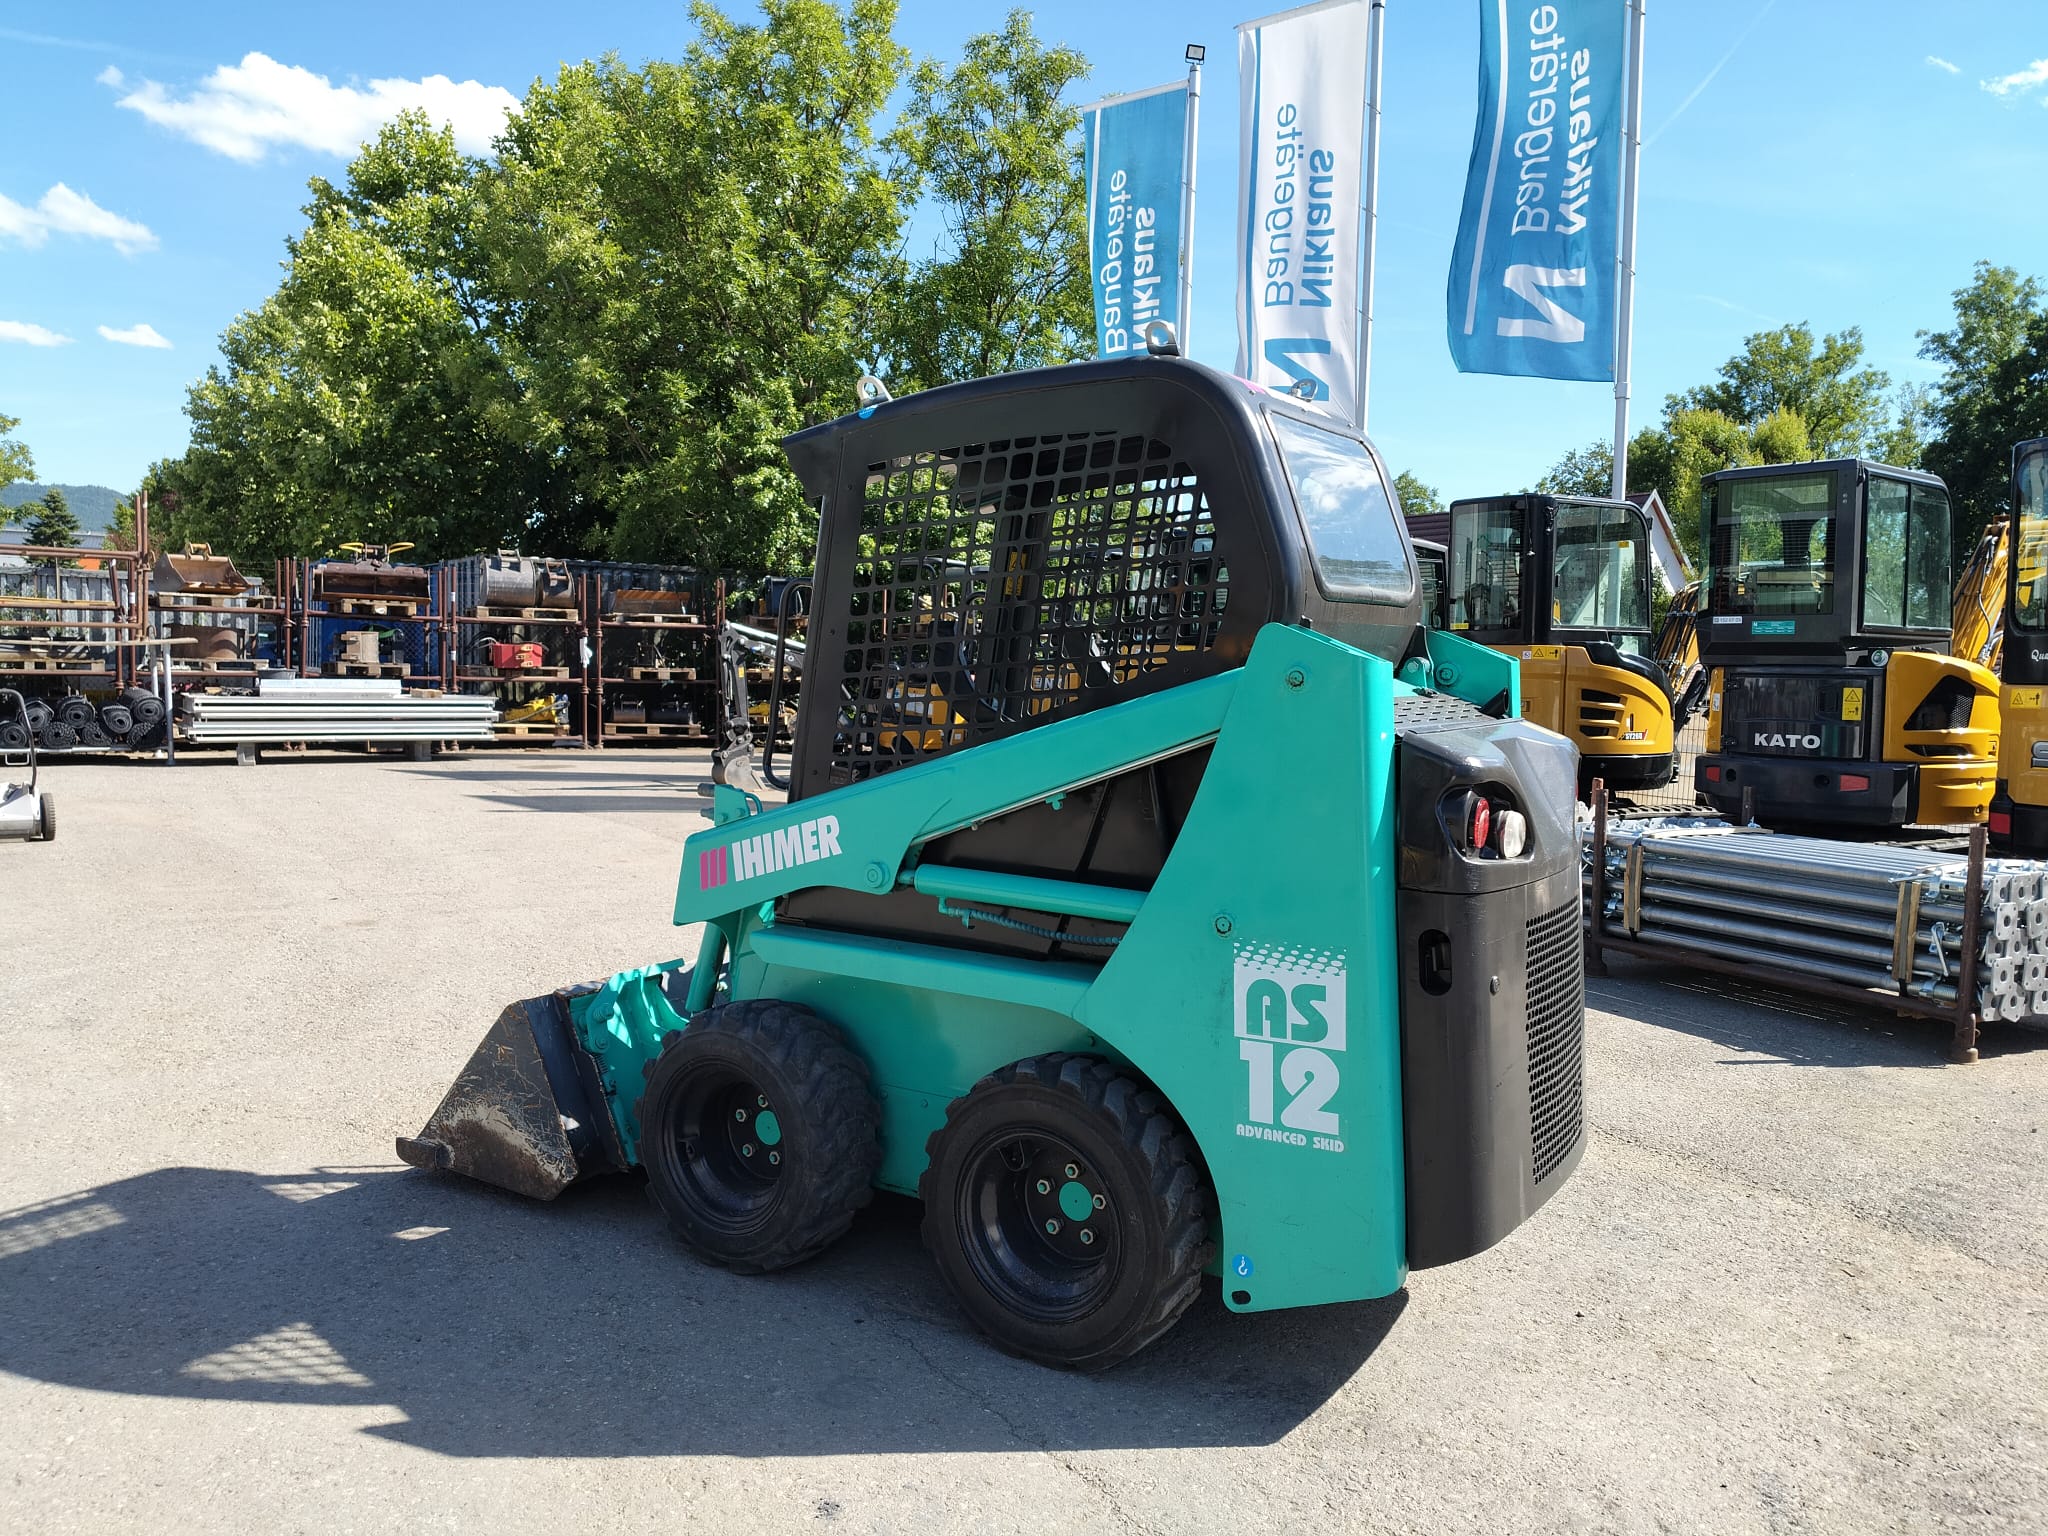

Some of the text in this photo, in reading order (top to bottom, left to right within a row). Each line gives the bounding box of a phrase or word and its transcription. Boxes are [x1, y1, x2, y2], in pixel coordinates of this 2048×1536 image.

[1754, 732, 1821, 749] KATO
[731, 814, 843, 882] IHIMER
[1246, 978, 1329, 1043] AS
[1239, 1039, 1340, 1136] 12
[1236, 1123, 1345, 1153] ADVANCED SKID
